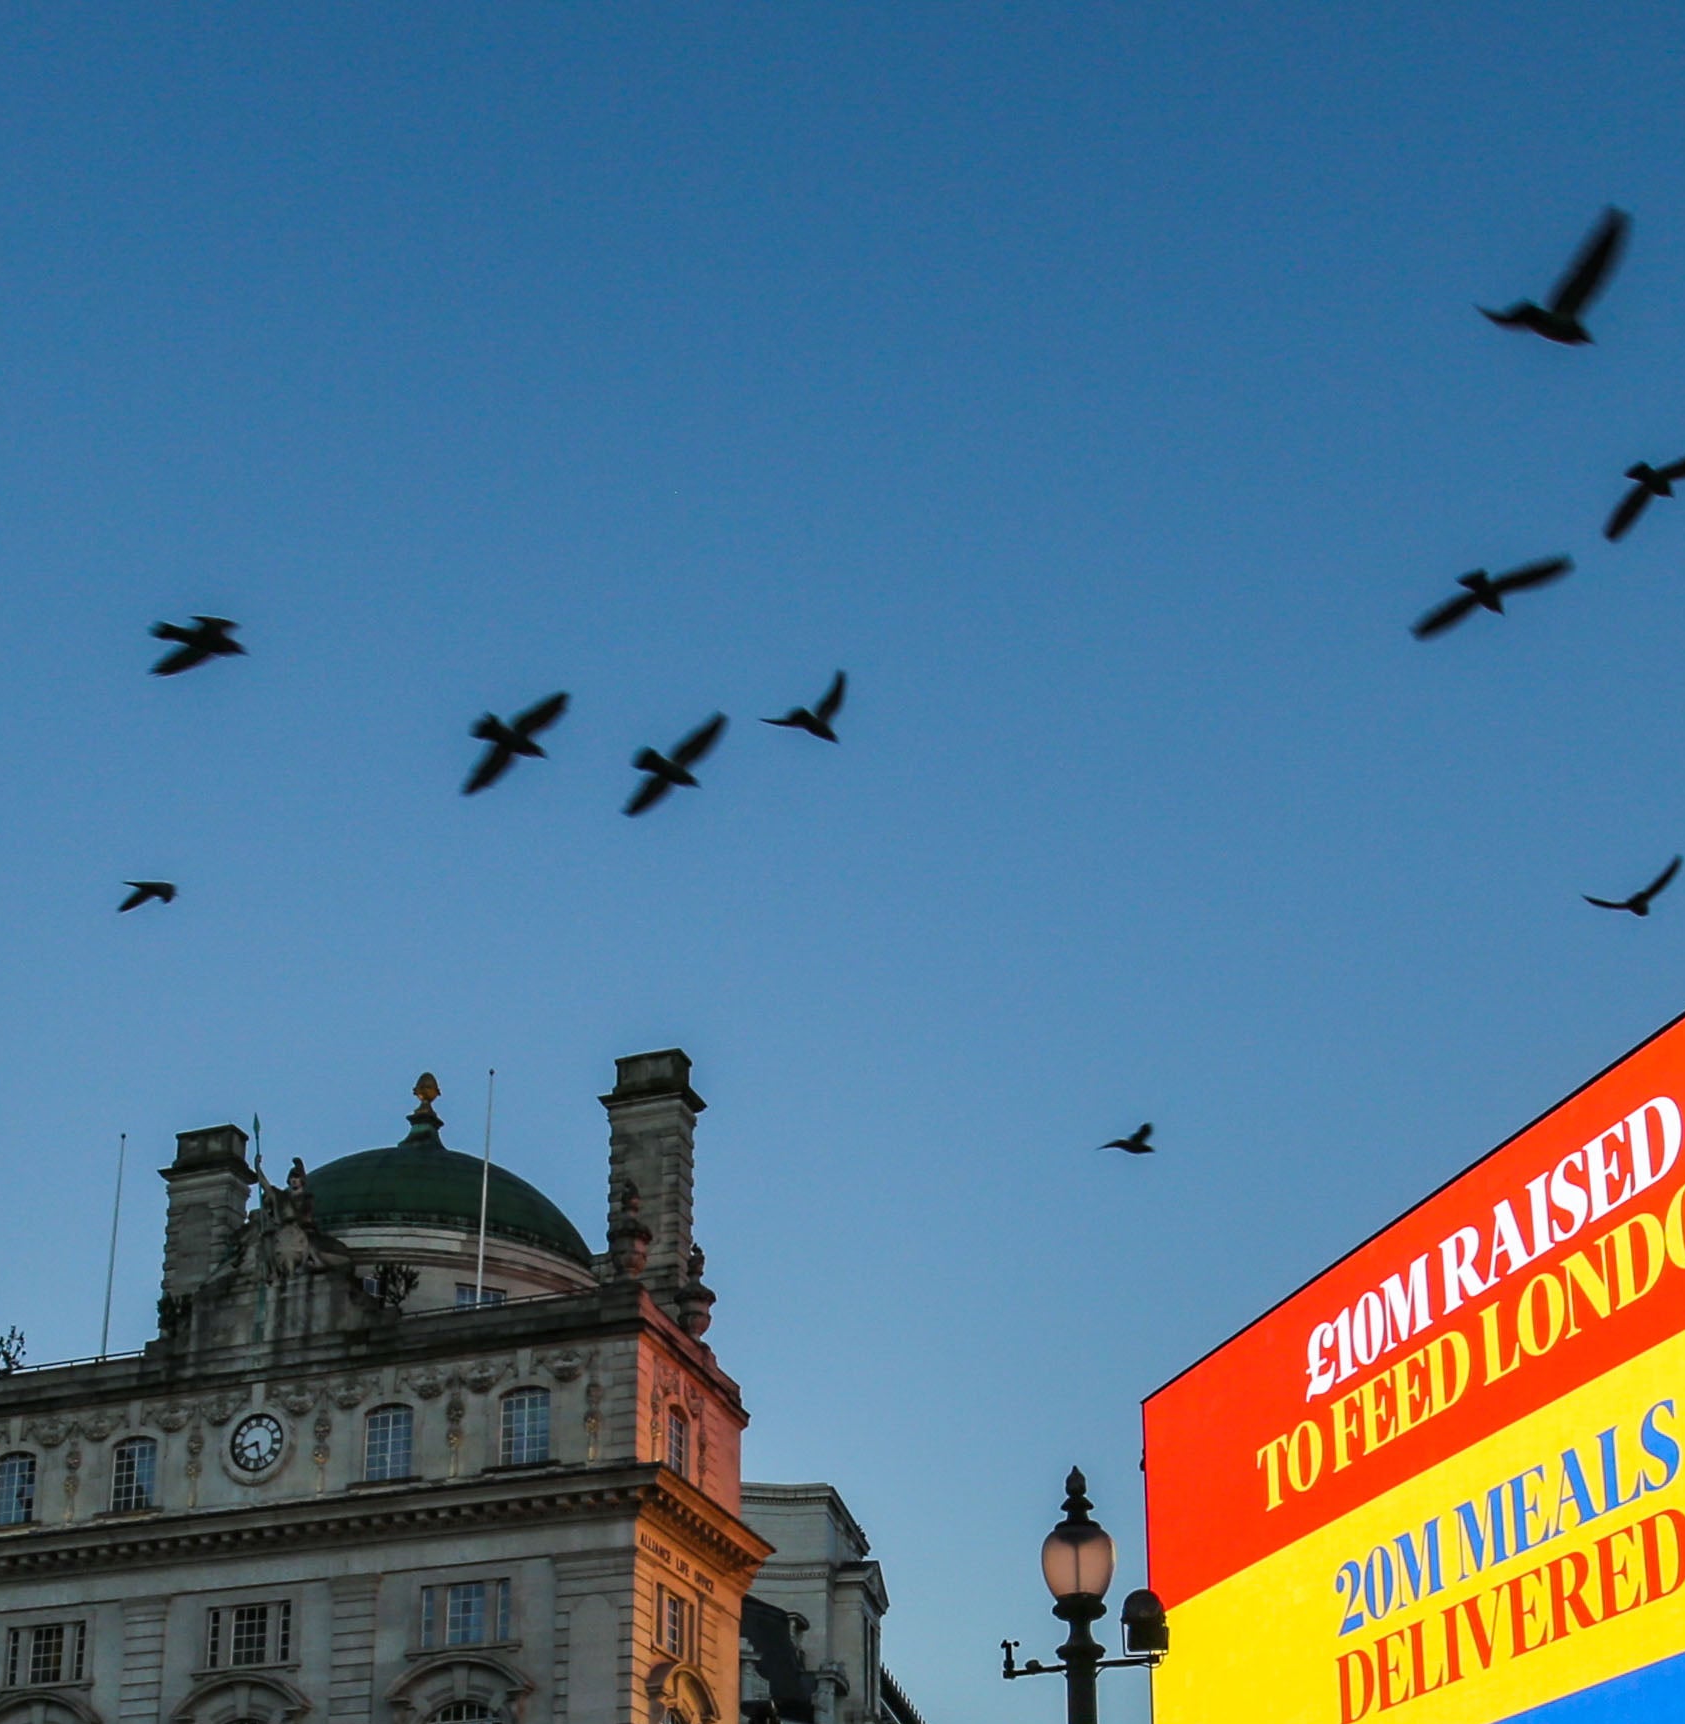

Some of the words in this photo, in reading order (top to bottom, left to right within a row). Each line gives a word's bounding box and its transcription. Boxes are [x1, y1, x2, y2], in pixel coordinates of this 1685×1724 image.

[1305, 1253, 1435, 1403] £10M
[1438, 1096, 1683, 1314] RAISED
[1256, 1420, 1323, 1512] TO
[1329, 1330, 1471, 1472] FEED
[1335, 1516, 1445, 1637] 20M
[1453, 1399, 1680, 1581] MEALS
